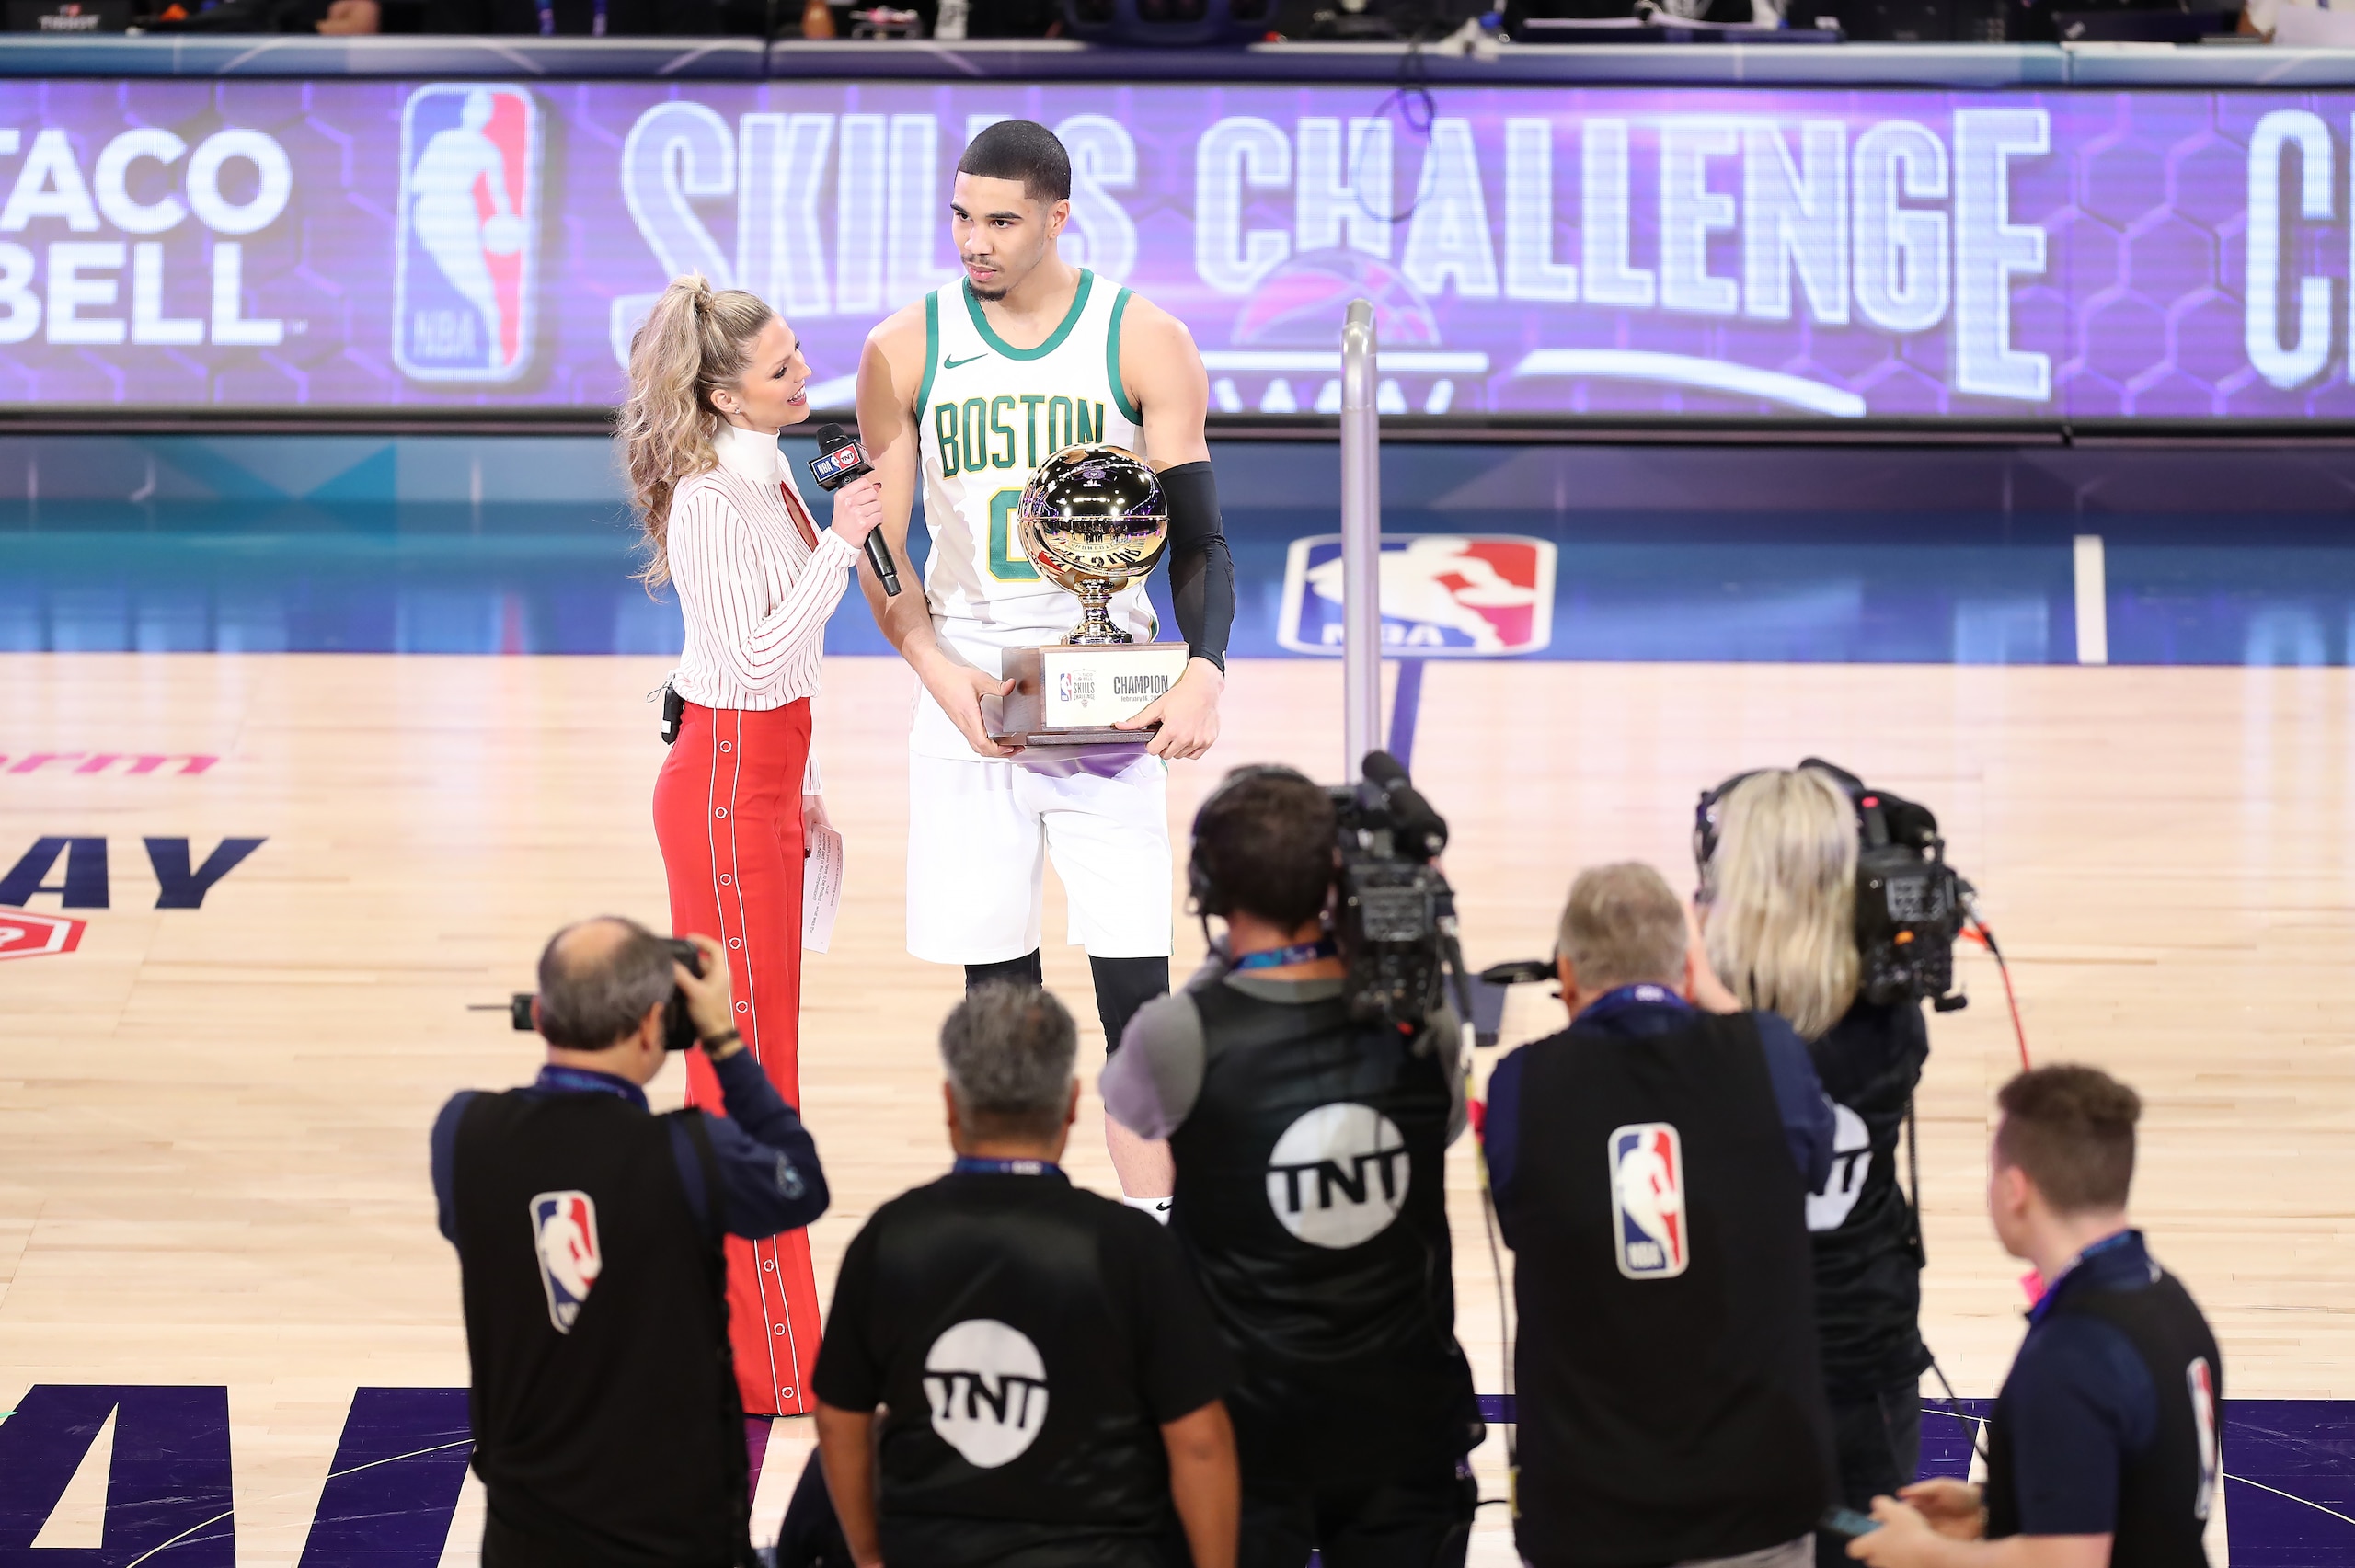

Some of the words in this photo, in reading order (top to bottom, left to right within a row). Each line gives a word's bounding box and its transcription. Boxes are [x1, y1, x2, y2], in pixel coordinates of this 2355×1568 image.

[0, 127, 293, 235] ACO
[611, 101, 1139, 370] SKILS
[1196, 108, 2051, 402] CHALLENGE
[817, 460, 833, 475] NBA
[841, 452, 855, 463] TNT
[935, 395, 1105, 480] BOSTON
[1073, 681, 1096, 694] SKILLS
[1113, 675, 1169, 695] CHAMPION
[0, 753, 220, 776] rm
[1268, 1147, 1410, 1213] TNT
[925, 1369, 1049, 1430] TNT
